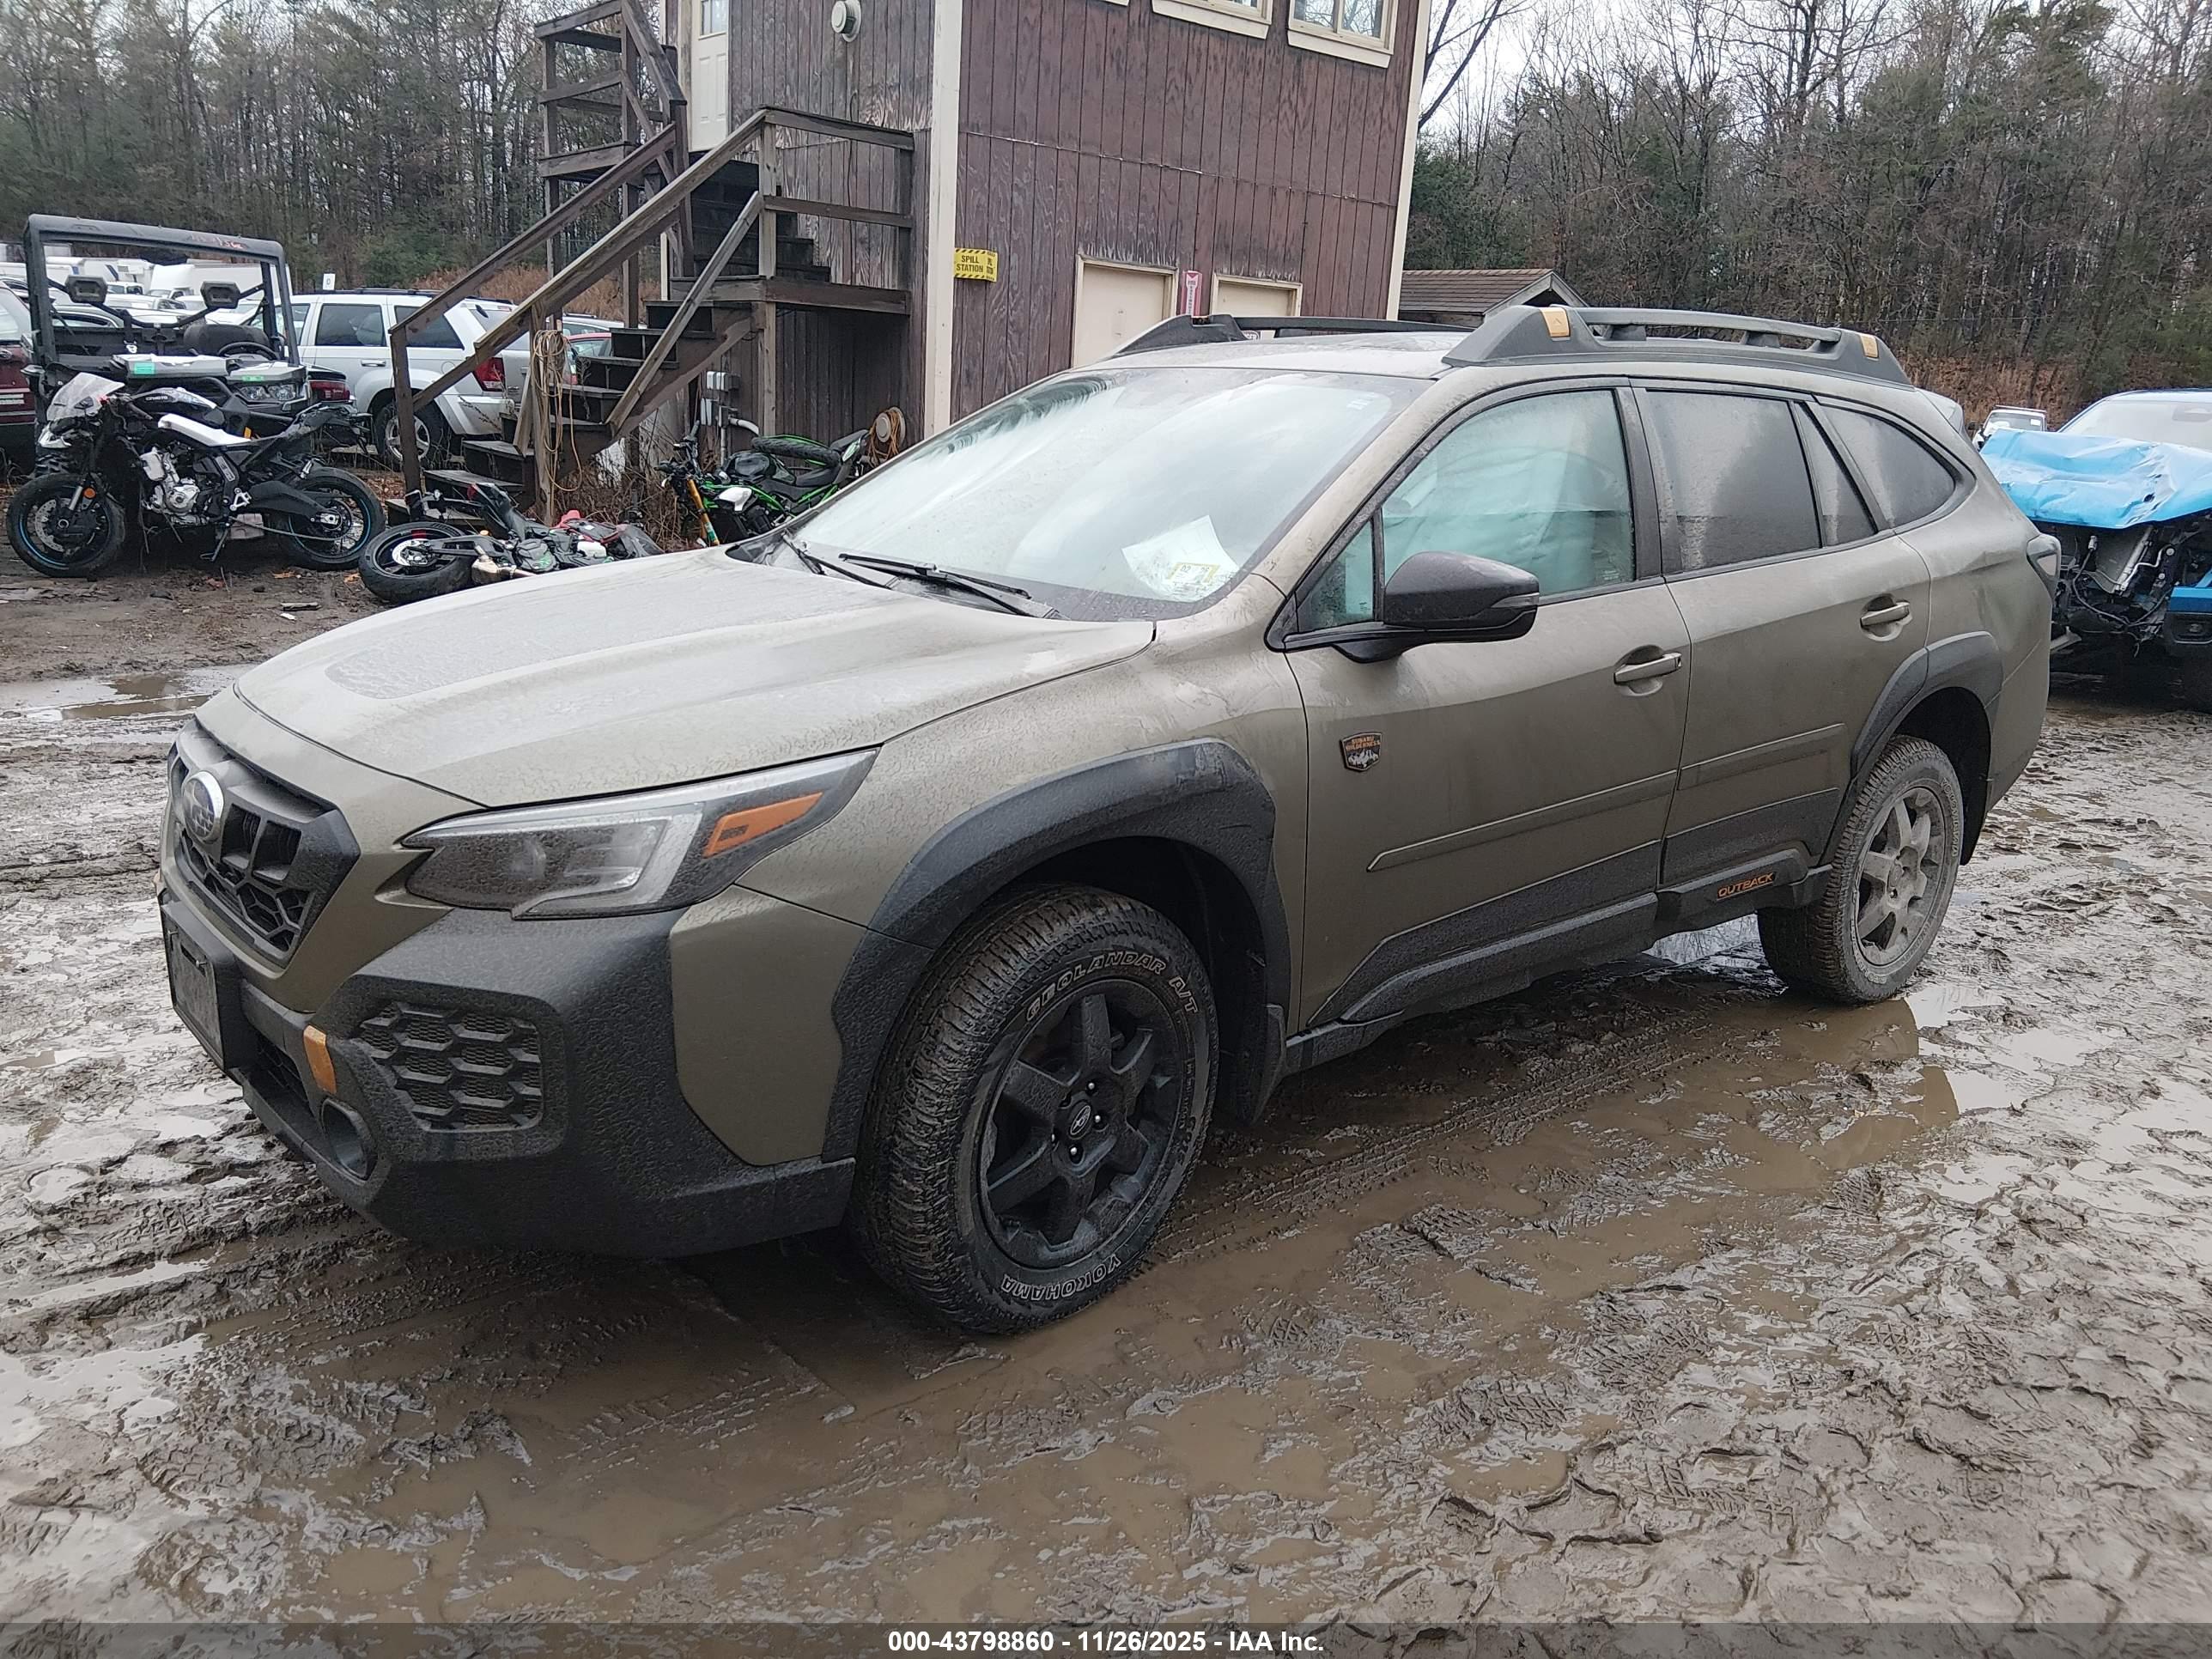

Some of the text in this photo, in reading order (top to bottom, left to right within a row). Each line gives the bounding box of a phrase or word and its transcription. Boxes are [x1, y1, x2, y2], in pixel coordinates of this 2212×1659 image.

[956, 263, 984, 273] STATION
[961, 255, 980, 264] SPILL
[1718, 872, 1774, 898] OUTBACK
[1026, 951, 1166, 1021] GEOLANDAR
[1000, 1254, 1122, 1301] YOKOHAMA
